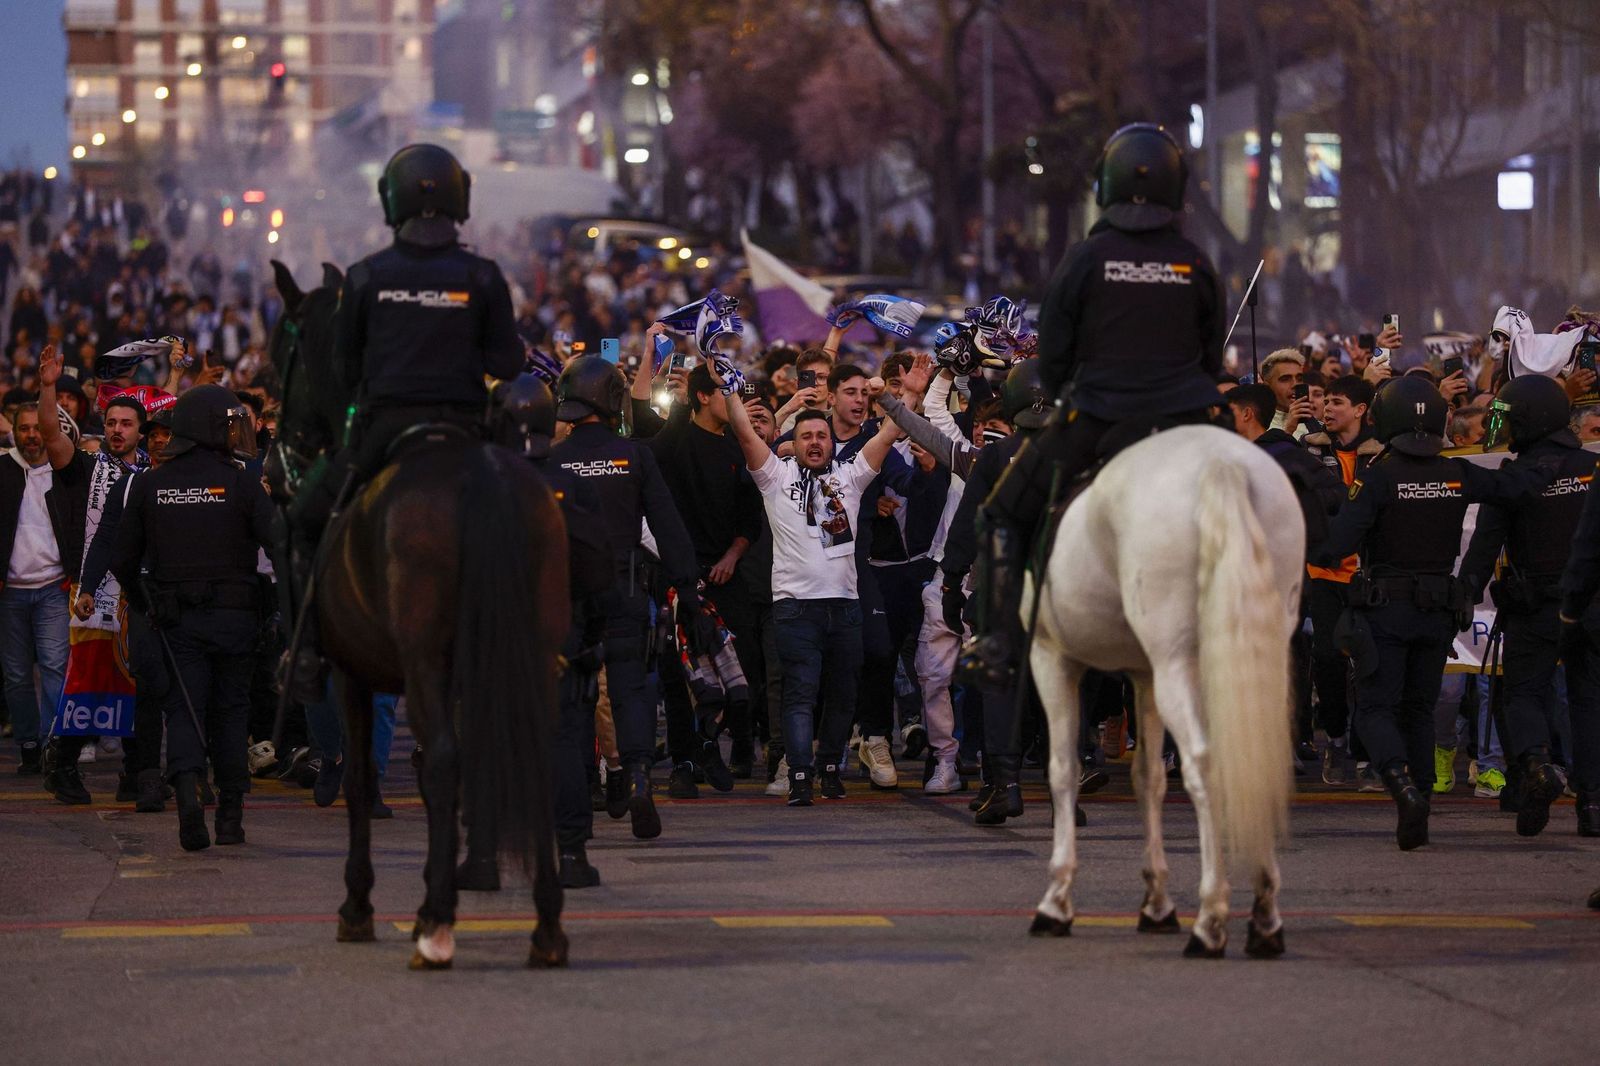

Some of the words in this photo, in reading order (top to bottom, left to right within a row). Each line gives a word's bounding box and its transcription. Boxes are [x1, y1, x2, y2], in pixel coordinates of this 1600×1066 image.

[1104, 261, 1174, 272] POLICIA
[1104, 271, 1192, 284] NACIONAL
[377, 289, 450, 302] POLICIA
[560, 459, 616, 470] POLICIA
[573, 466, 630, 477] CIONAL
[1397, 481, 1449, 491] POLICIA
[1546, 476, 1582, 488] ICIA
[90, 484, 101, 510] LEAGUE
[156, 487, 211, 497] POLICIA
[1398, 489, 1462, 500] NACIONAL
[157, 495, 226, 505] NACIONAL
